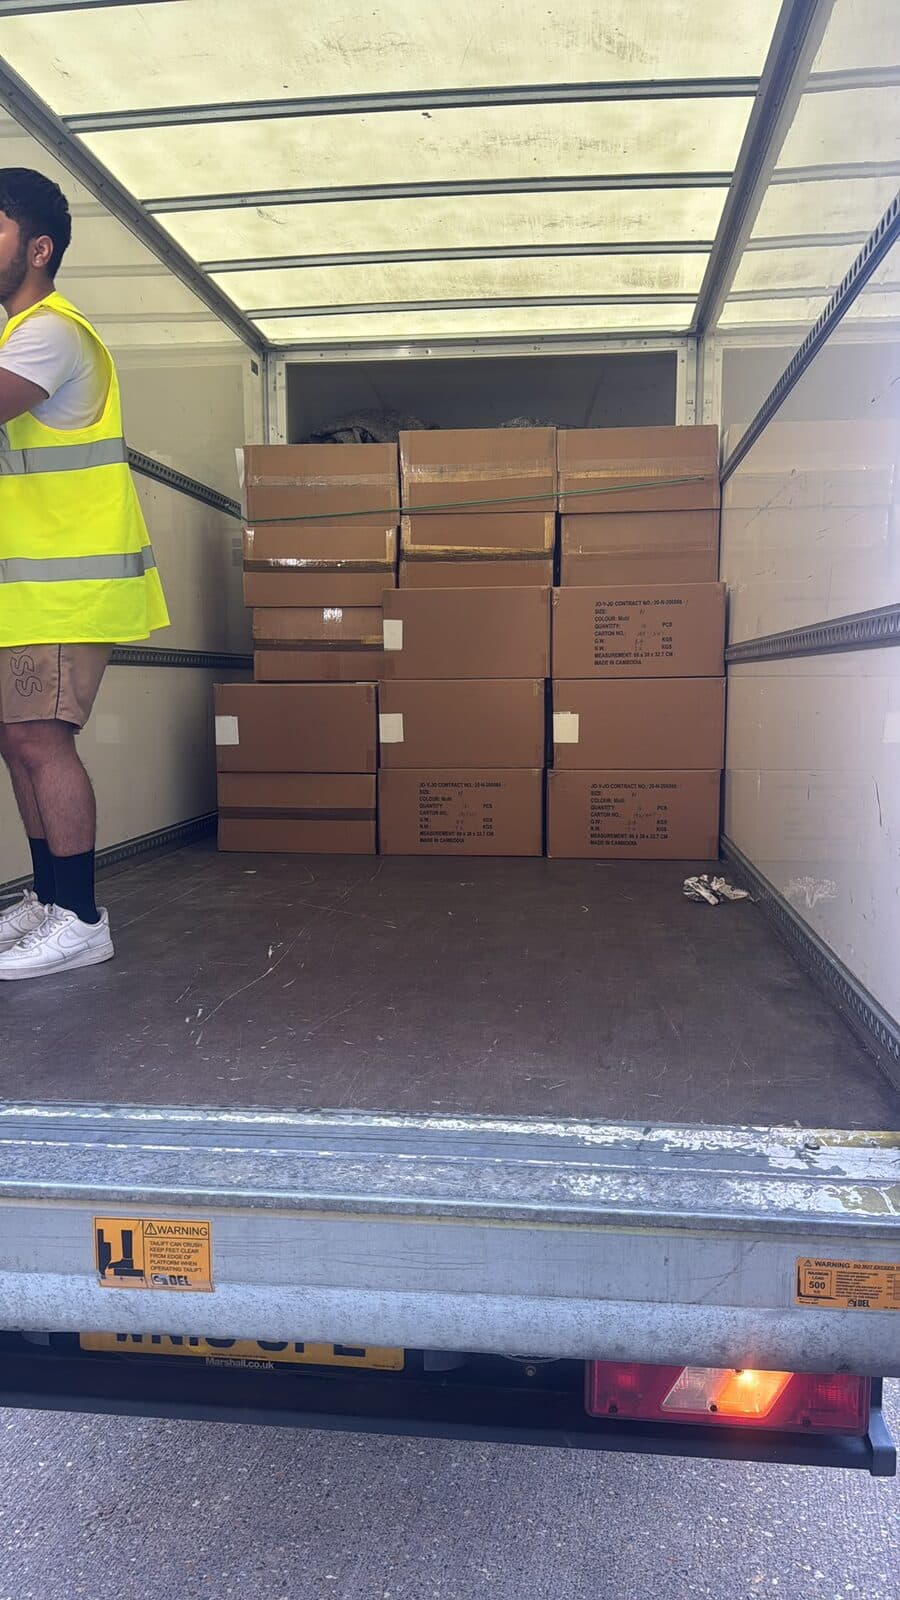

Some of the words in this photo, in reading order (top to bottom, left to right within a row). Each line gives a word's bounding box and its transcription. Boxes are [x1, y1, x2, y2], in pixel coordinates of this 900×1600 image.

[157, 1226, 208, 1236] WARNING
[168, 1275, 192, 1286] DEL
[206, 1357, 274, 1369] Marshall.co.uk
